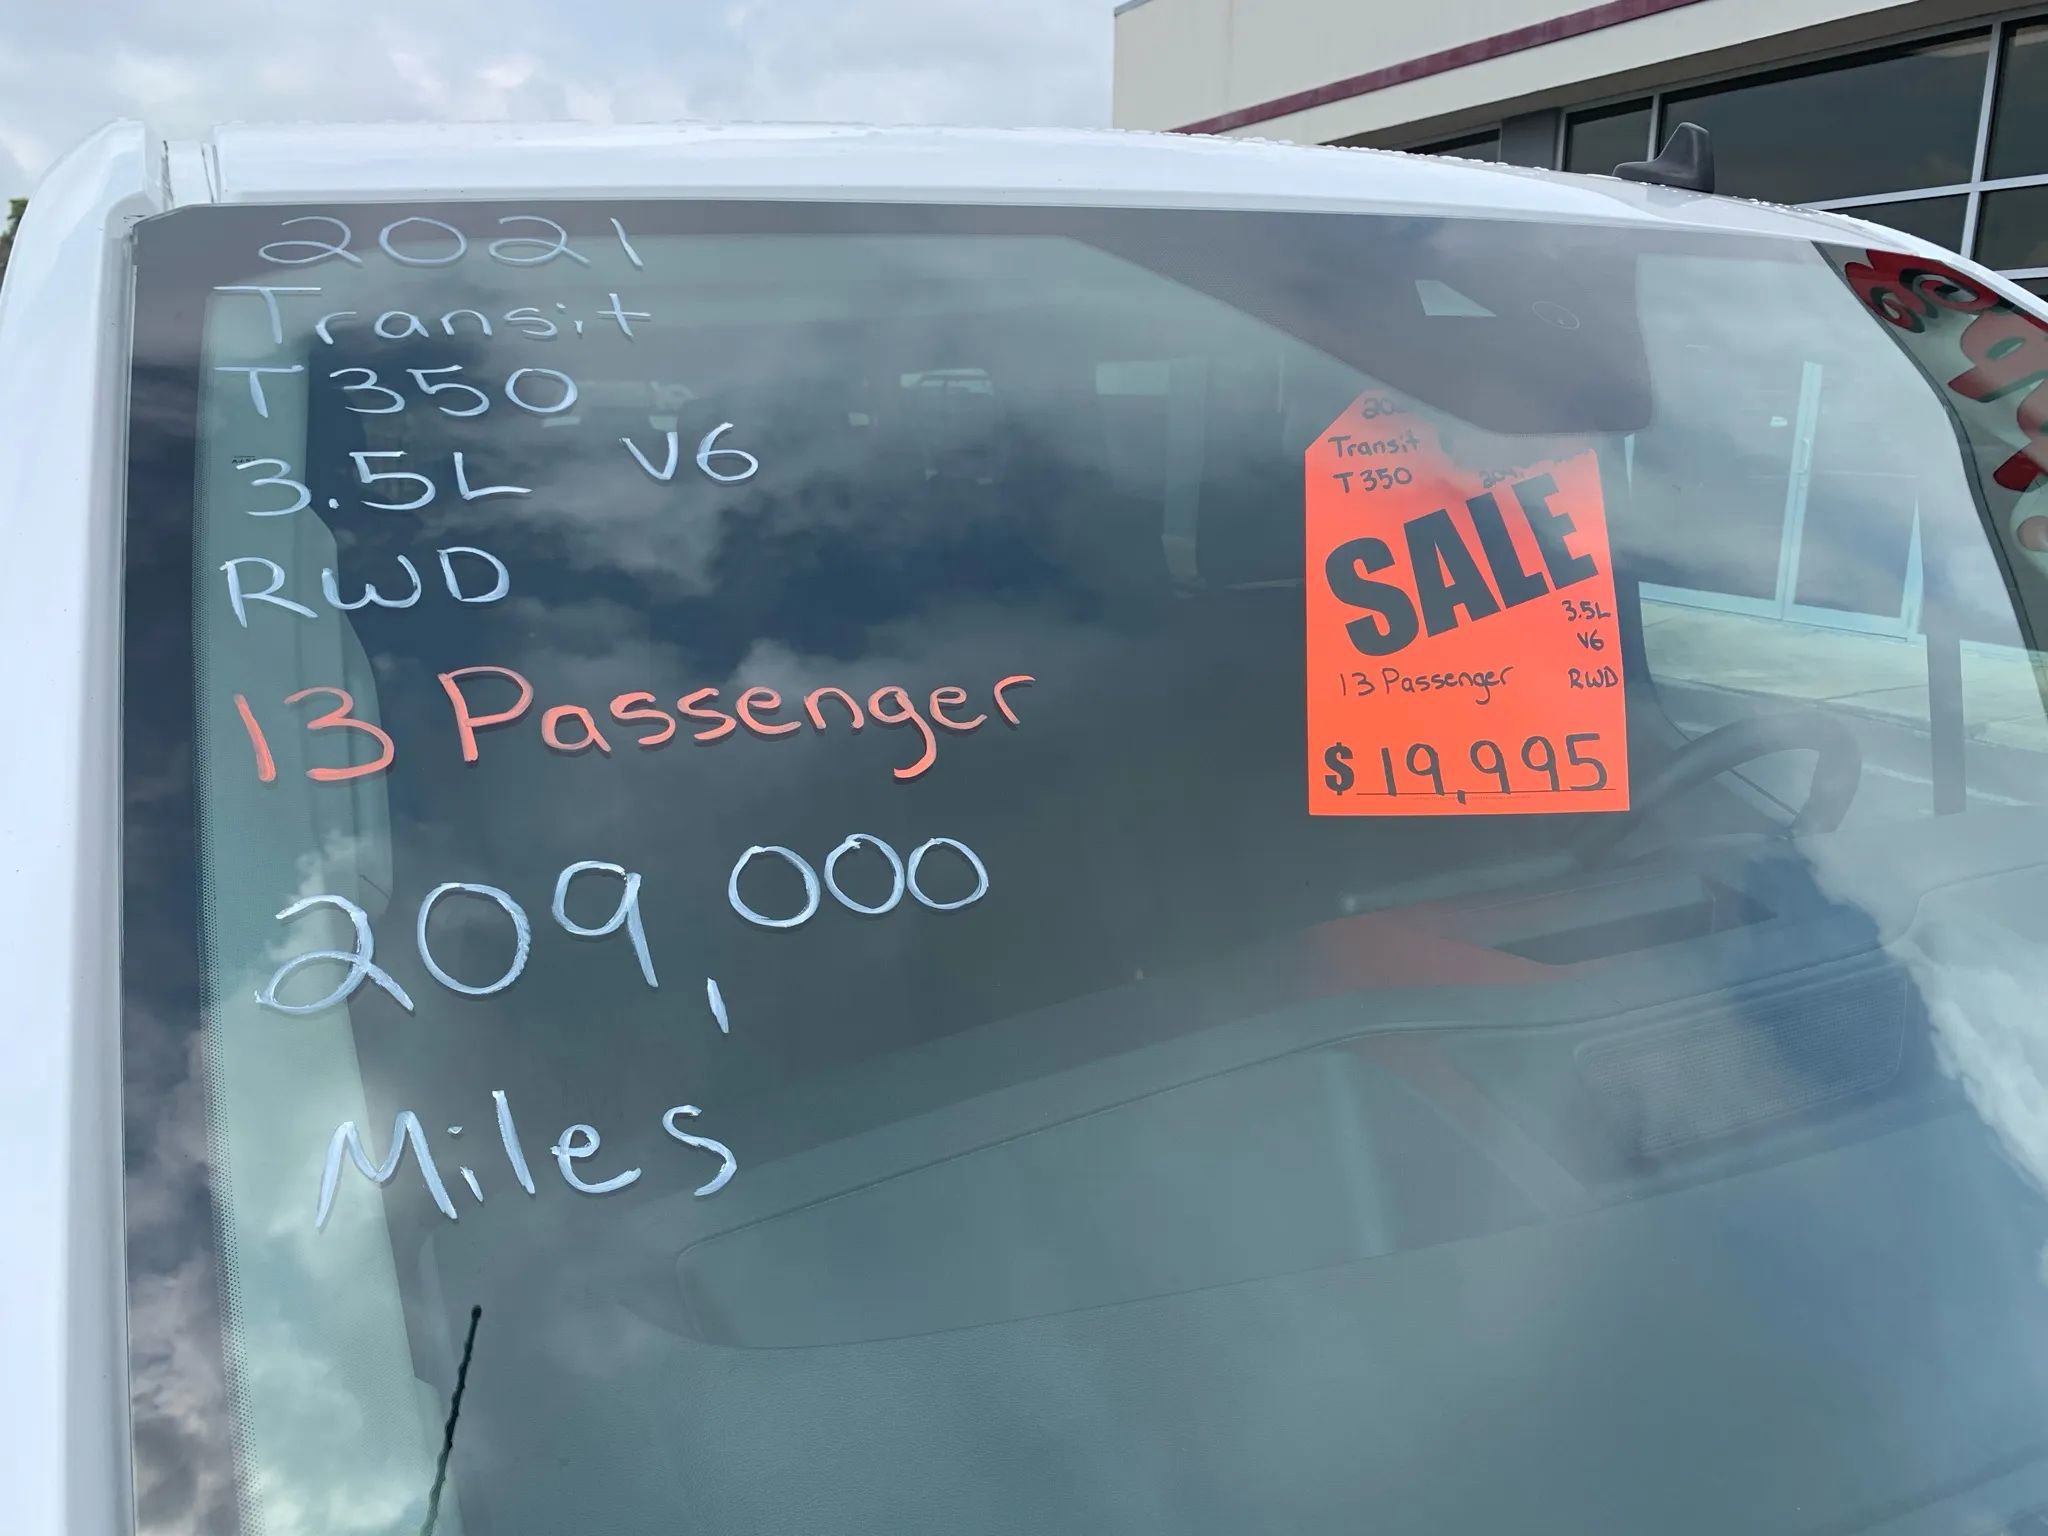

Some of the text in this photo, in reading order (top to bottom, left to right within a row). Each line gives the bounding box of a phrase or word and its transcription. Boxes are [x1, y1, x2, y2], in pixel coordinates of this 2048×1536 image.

[259, 216, 643, 267] 2021
[213, 286, 652, 344] Transit
[213, 364, 578, 418] T 350
[236, 422, 760, 518] 3.5L V6
[1327, 430, 1420, 459] Transit
[1332, 466, 1413, 494] T 350
[219, 546, 510, 628] RWD
[1325, 472, 1599, 656] SALE
[1561, 600, 1611, 622] 3.5L
[1577, 630, 1604, 651] V6
[1340, 666, 1515, 705] 13 Passenger
[1568, 666, 1619, 690] RWD
[233, 665, 1038, 783] 13 Passenger
[254, 832, 990, 1034] 209,000
[315, 1090, 738, 1231] Miles
